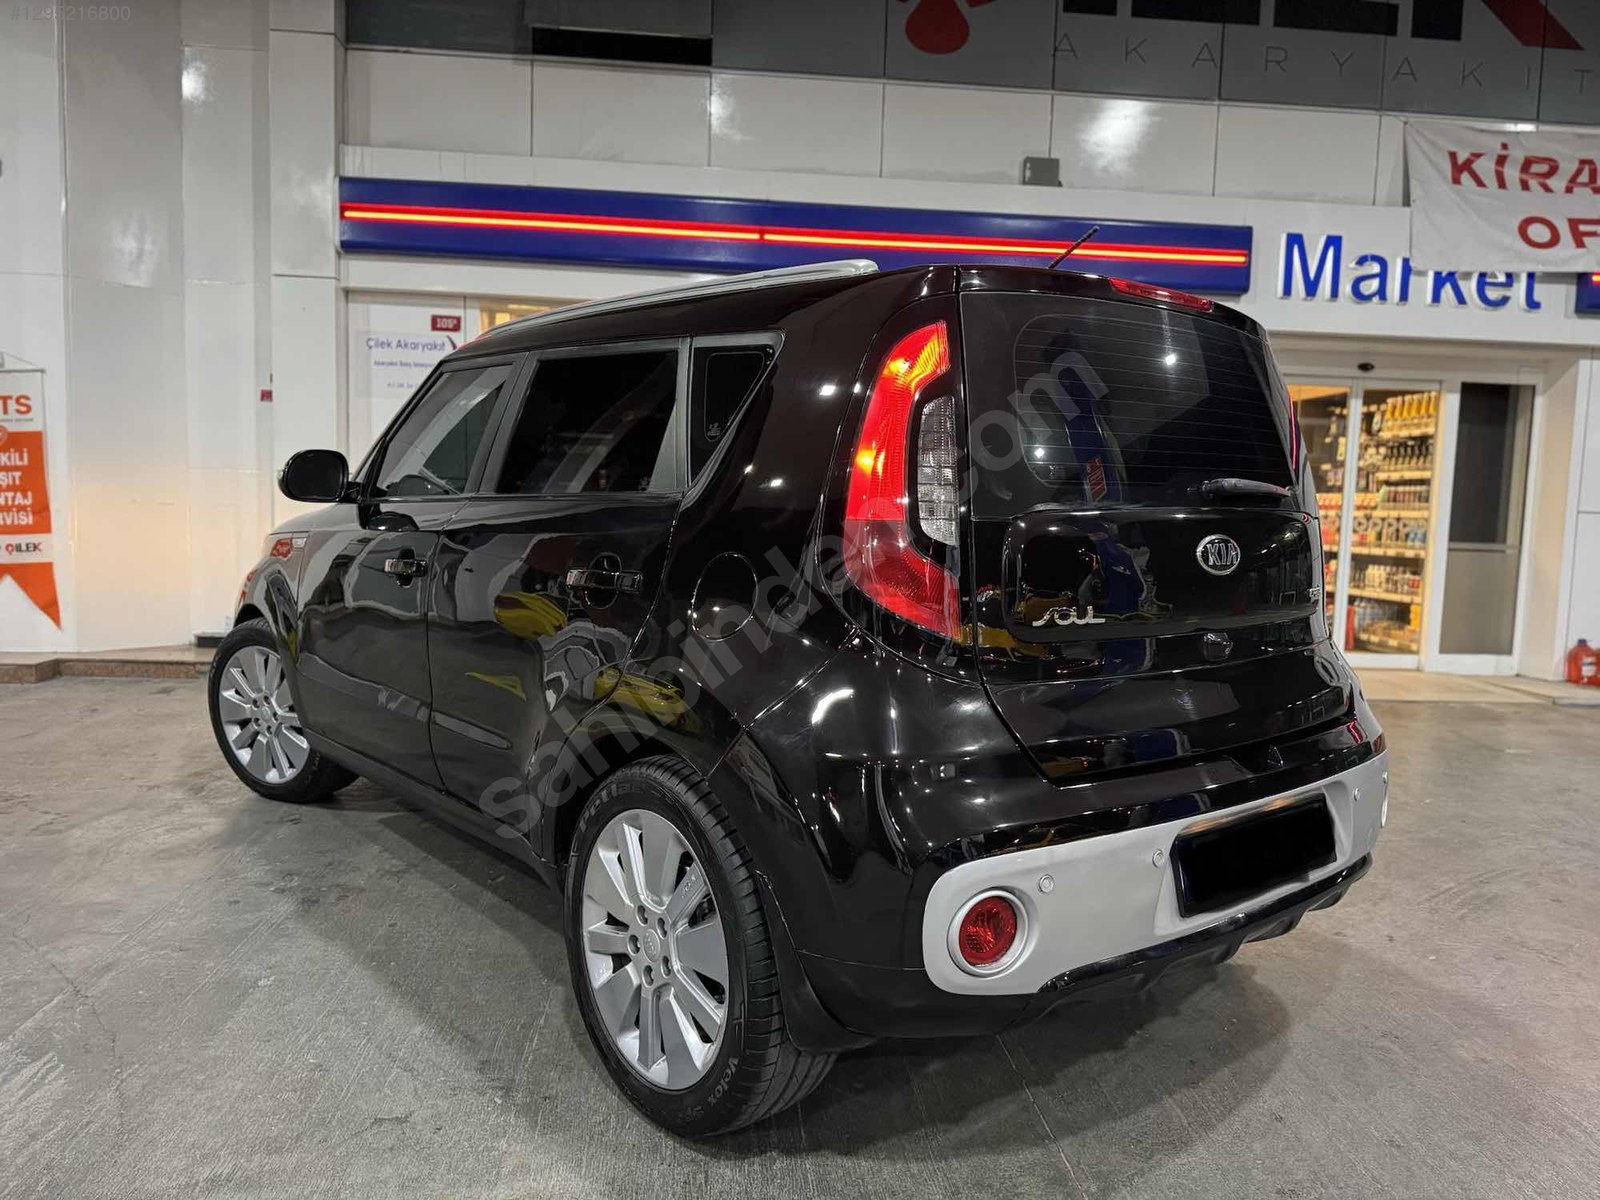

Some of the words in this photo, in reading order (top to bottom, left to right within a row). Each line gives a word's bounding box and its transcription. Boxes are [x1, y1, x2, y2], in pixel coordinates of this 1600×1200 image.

[1051, 32, 1595, 94] AKARYAKIT
[366, 337, 393, 350] Çilek
[0, 394, 32, 415] TS
[1207, 543, 1238, 566] KIA
[1032, 605, 1105, 626] SOUL
